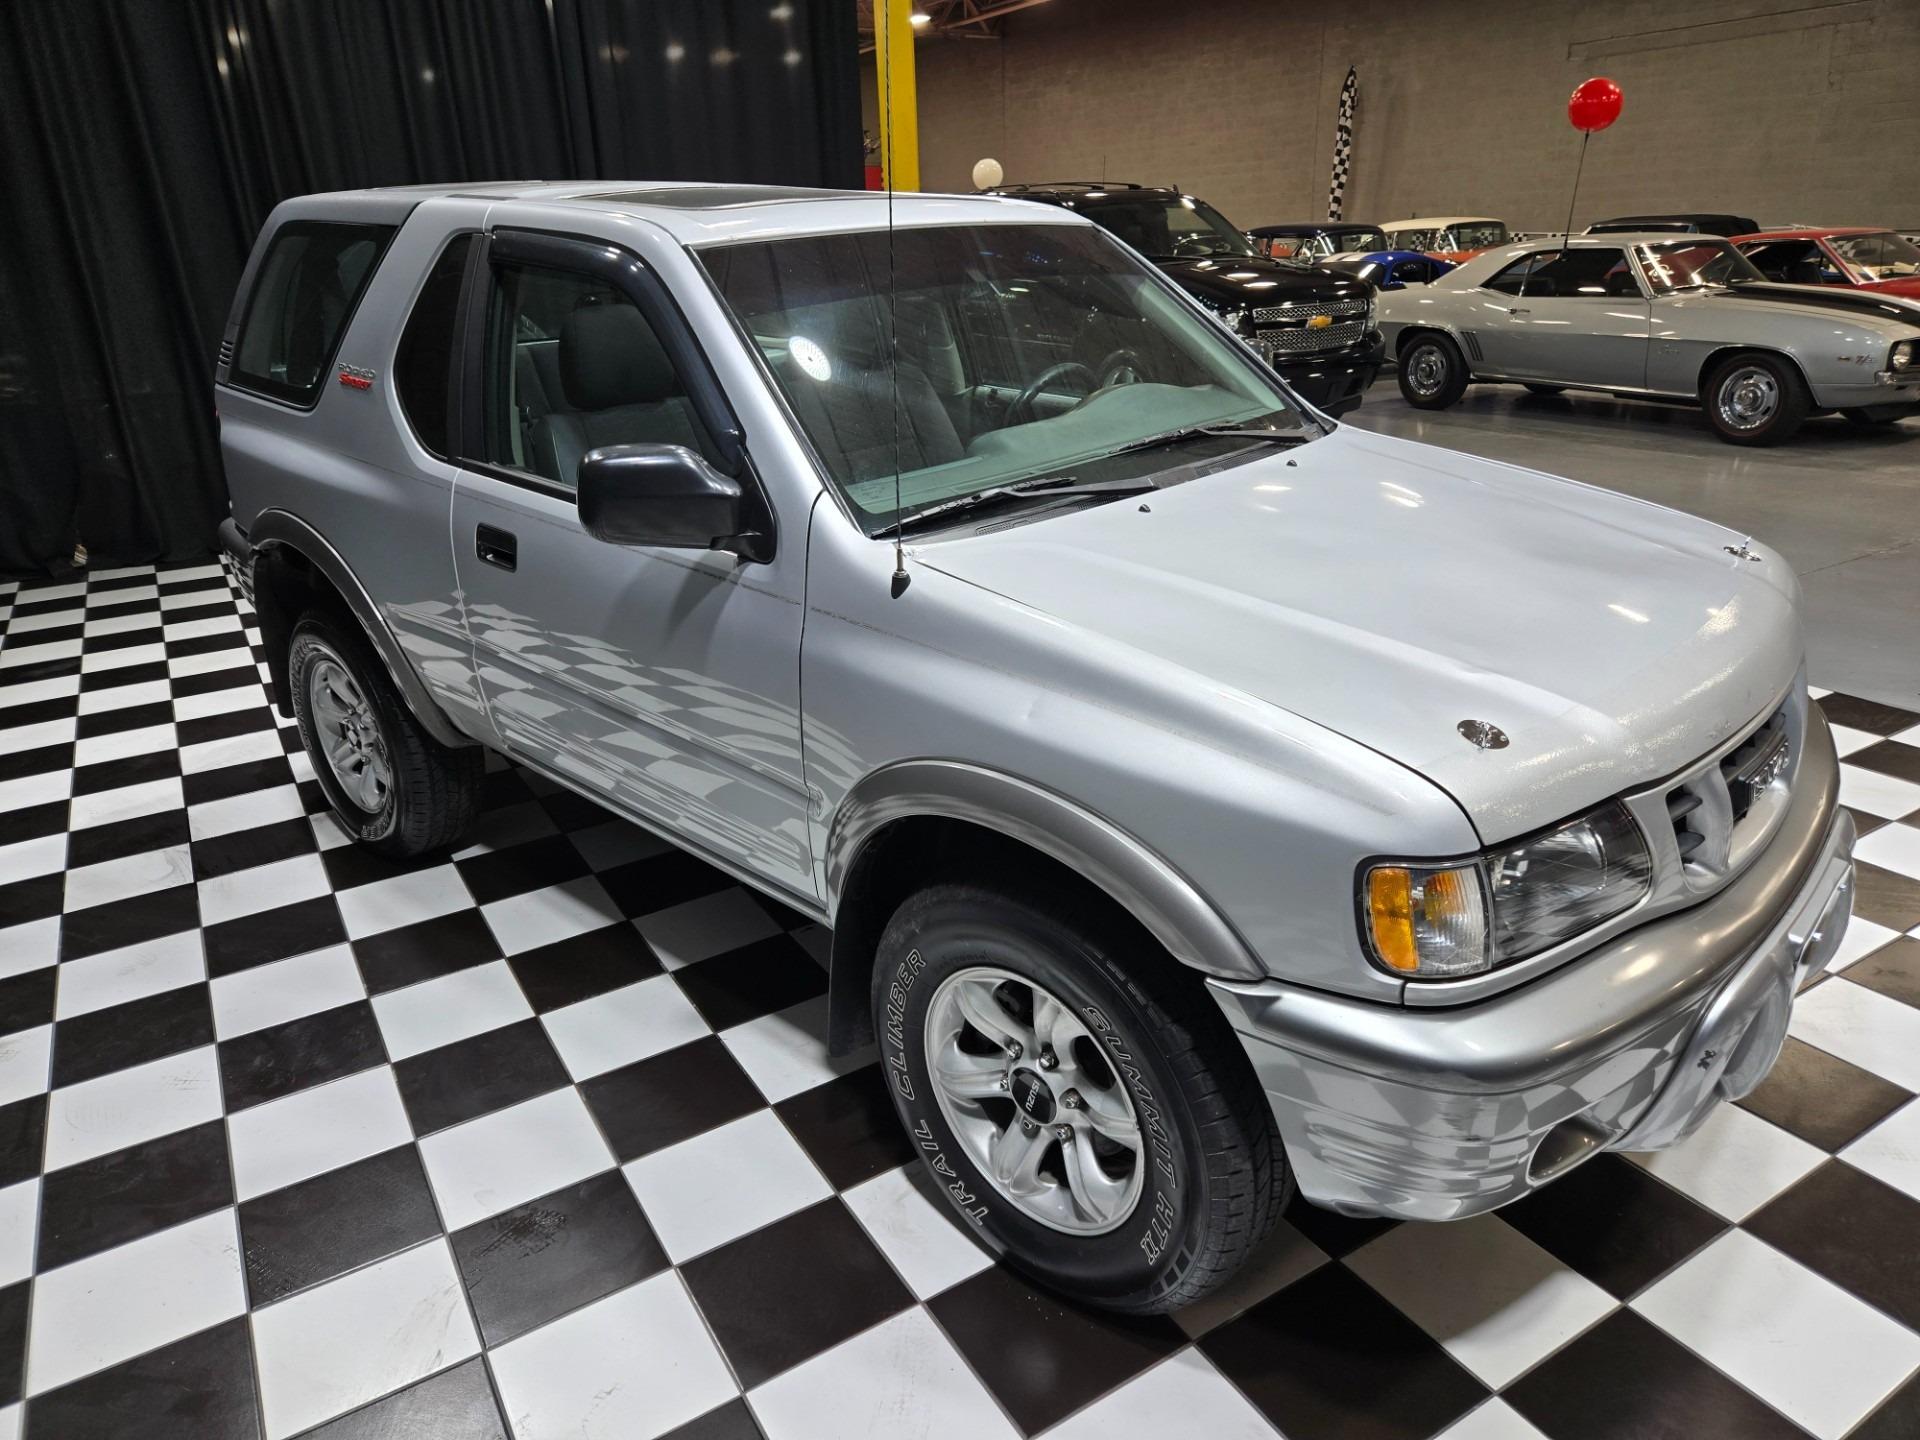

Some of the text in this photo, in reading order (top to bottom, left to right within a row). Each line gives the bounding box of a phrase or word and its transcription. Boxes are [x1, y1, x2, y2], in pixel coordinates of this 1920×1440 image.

[887, 949, 989, 1226] TRAIL CLIMBER
[1025, 1079, 1040, 1113] ISUZU
[1083, 1006, 1177, 1189] SUMMIT
